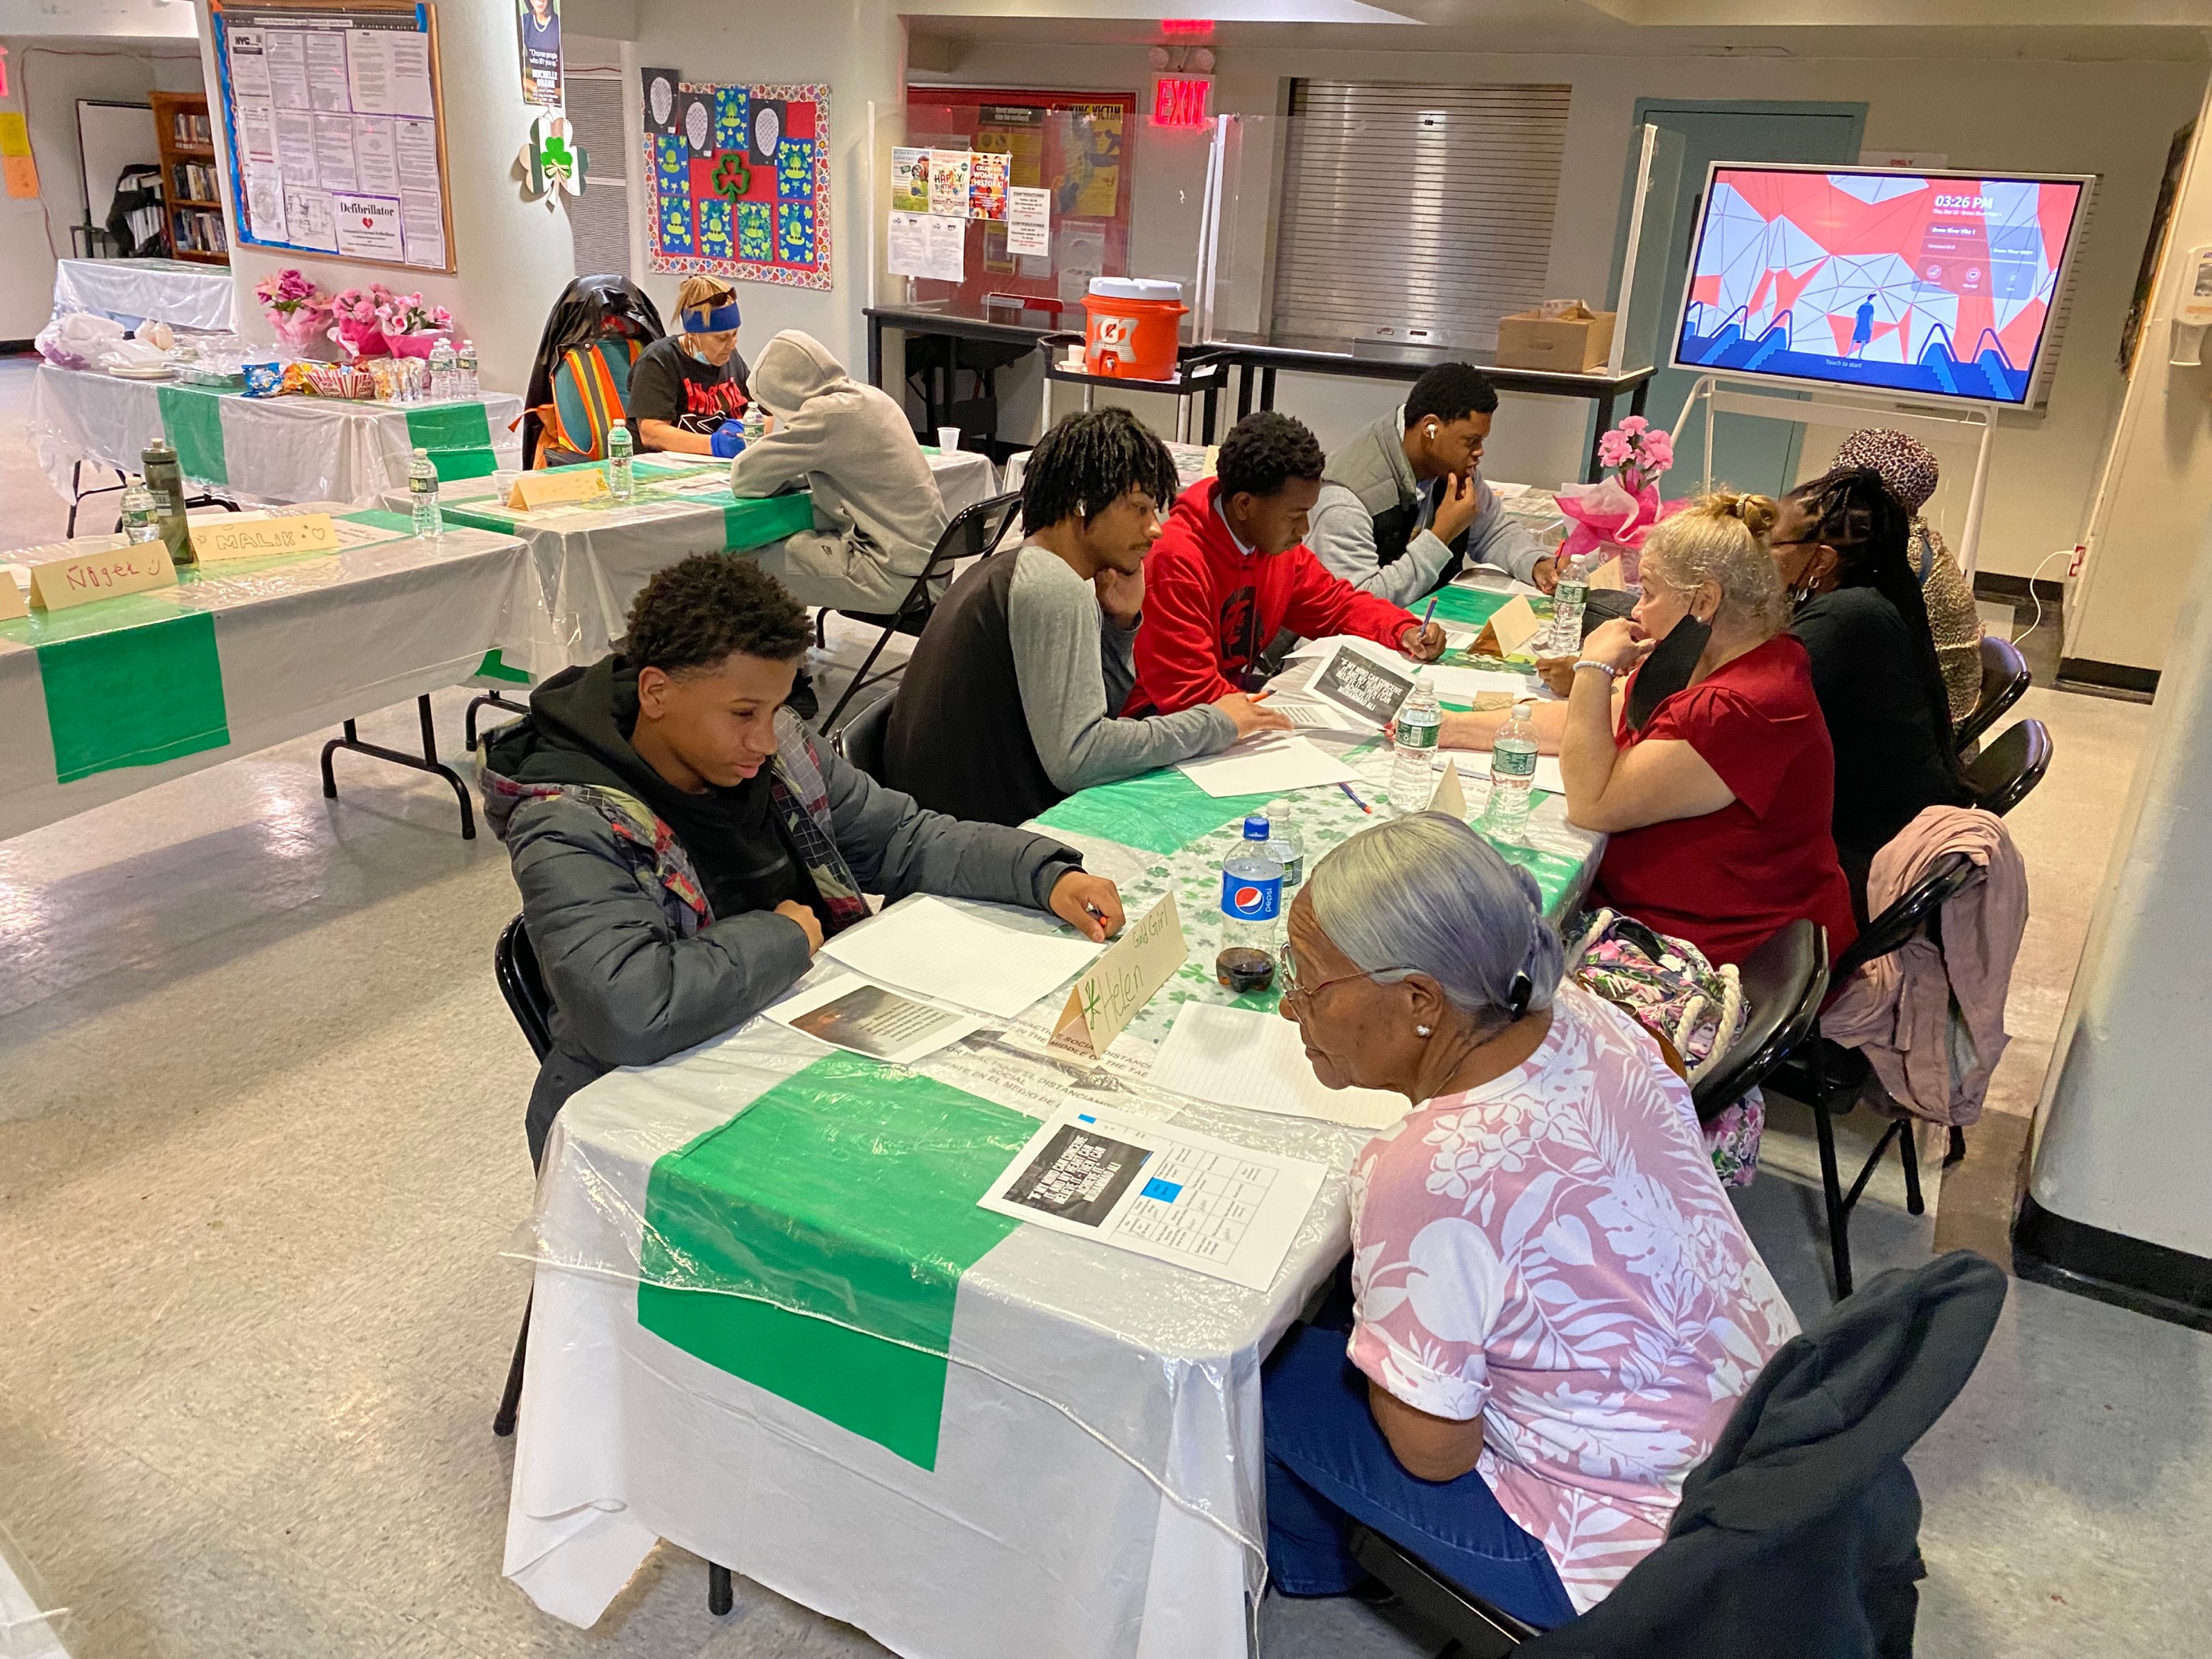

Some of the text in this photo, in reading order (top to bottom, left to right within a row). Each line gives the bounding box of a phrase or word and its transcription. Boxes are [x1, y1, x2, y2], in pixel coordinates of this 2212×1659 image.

[234, 36, 250, 45] NYC
[1091, 104, 1121, 120] VICTIM
[1155, 78, 1210, 125] EXIT
[934, 174, 963, 184] HAPPY
[973, 171, 1005, 180] WOMEN'S
[340, 202, 394, 217] Defibrillator
[1935, 194, 1994, 210] 03:26 PM
[1335, 670, 1356, 685] BELIEVE
[1364, 685, 1378, 697] THEN
[1379, 694, 1390, 704] CAN
[1344, 683, 1366, 698] ACHIEVE
[1346, 661, 1356, 670] MY
[1355, 666, 1368, 677] MIND
[1367, 673, 1379, 683] CAN
[1378, 678, 1402, 695] CONCEIVE
[1347, 669, 1359, 679] AND
[1357, 675, 1367, 684] MY
[1365, 679, 1382, 692] HEART
[1381, 688, 1393, 698] CAN
[1337, 685, 1375, 710] MUHAMMAD ALI
[1149, 904, 1168, 937] Girl
[1097, 965, 1143, 1032] Helen
[1028, 1031, 1049, 1044] THE
[1048, 1041, 1086, 1057] MIDDLE
[1105, 1060, 1127, 1070] THE
[1128, 1067, 1149, 1078] TAB
[1064, 1037, 1094, 1050] SOCIA
[971, 1071, 988, 1080] EN
[987, 1075, 1001, 1084] EL
[1002, 1081, 1038, 1100] MEDIO
[1038, 1096, 1055, 1107] DE
[988, 1068, 1027, 1086] SOCIAL
[1033, 1182, 1049, 1193] MY
[1041, 1169, 1060, 1184] MIND
[1052, 1158, 1069, 1171] CAN
[1061, 1135, 1087, 1159] CONCEIVE
[1049, 1180, 1065, 1192] AND
[1057, 1171, 1072, 1181] MY
[1065, 1154, 1085, 1173] HEART
[1077, 1144, 1094, 1156] CAN
[1053, 1182, 1078, 1204] BELIEVE
[1077, 1159, 1096, 1174] THEN
[1089, 1146, 1105, 1158] CAN
[1076, 1171, 1100, 1194] ACHIEVE
[1083, 1162, 1121, 1202] MUHAMMAD ALI
